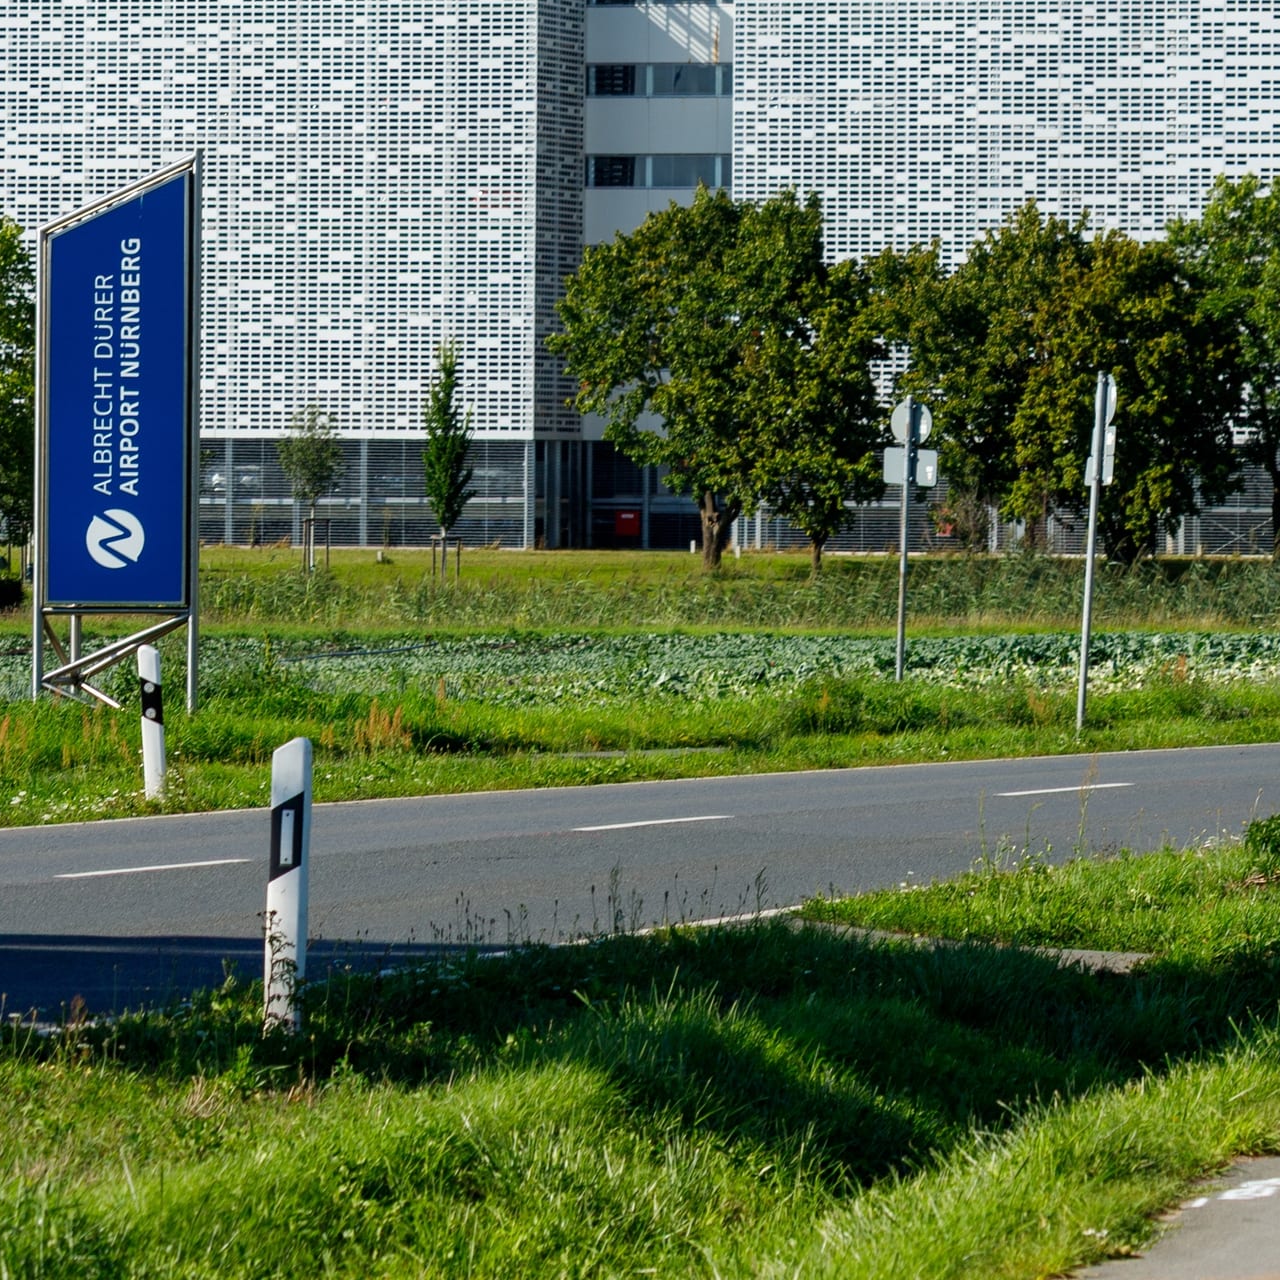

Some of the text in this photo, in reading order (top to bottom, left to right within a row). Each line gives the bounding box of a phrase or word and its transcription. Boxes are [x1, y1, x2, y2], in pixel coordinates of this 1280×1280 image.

[93, 274, 114, 496] ALBRECHT DÜRER
[119, 237, 142, 497] AIRPORT NÜRNBERG
